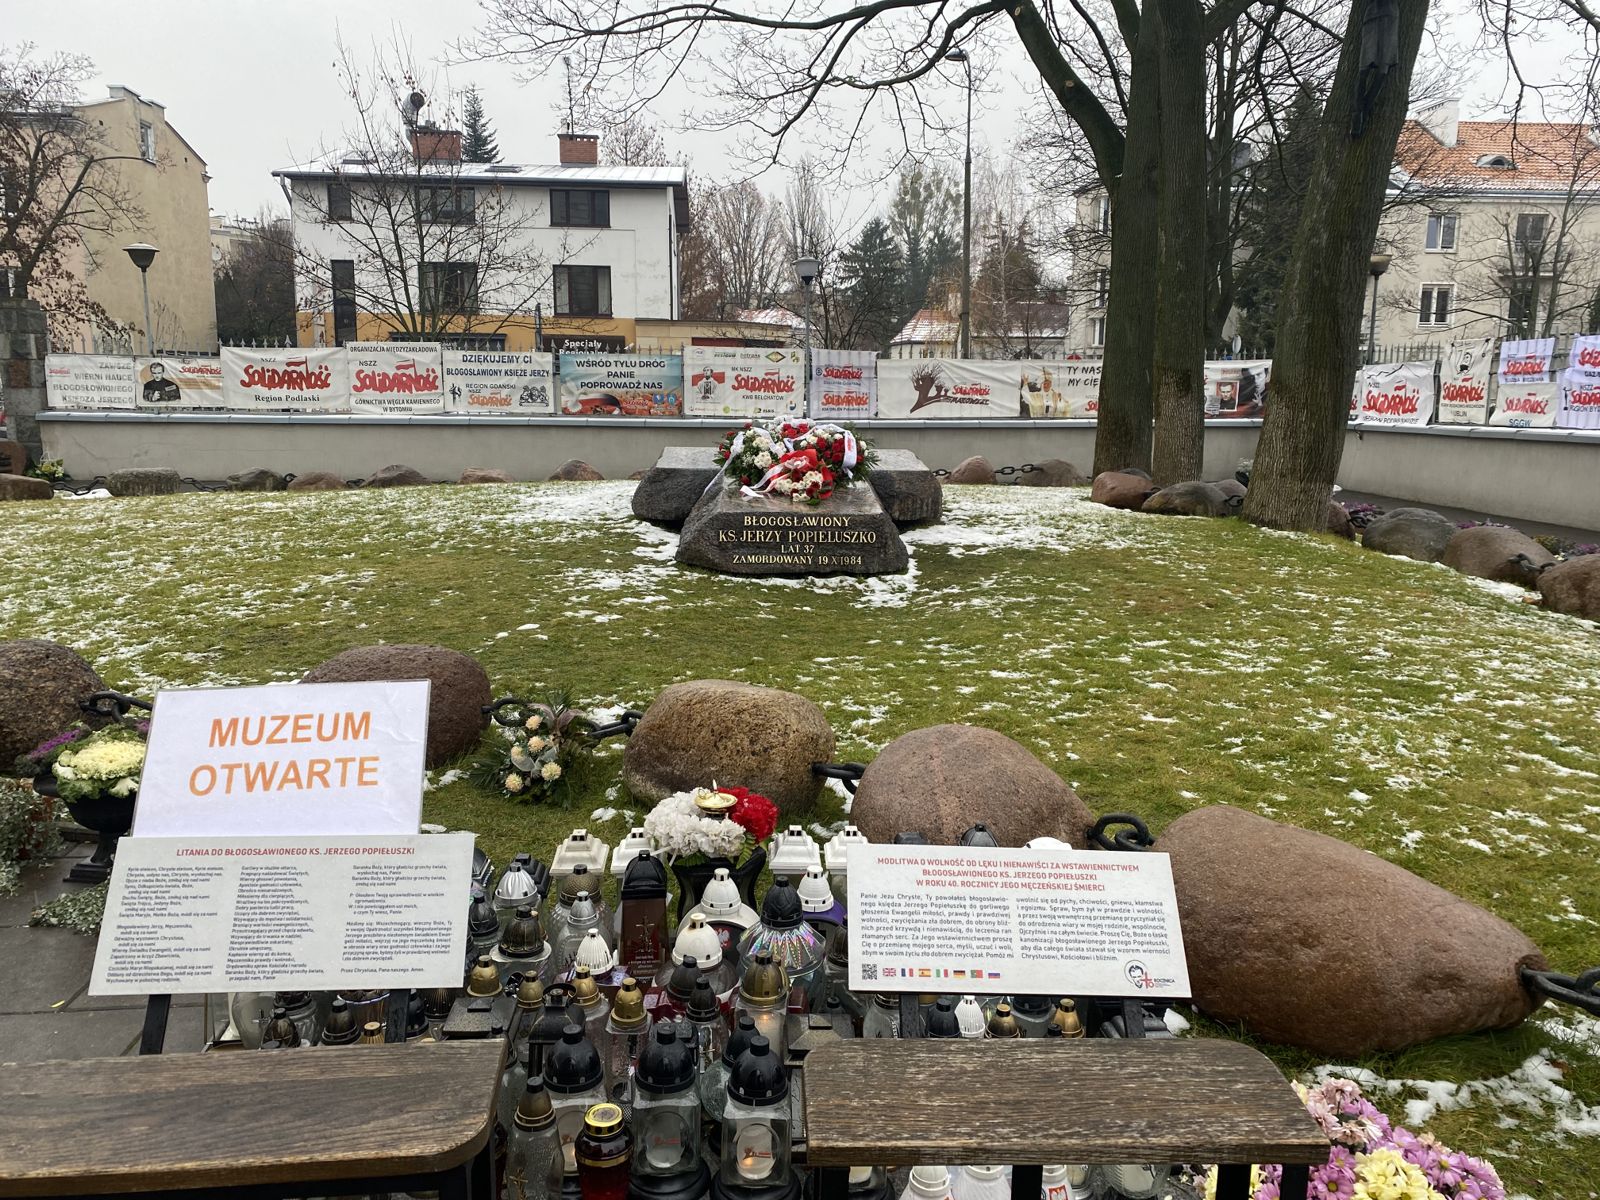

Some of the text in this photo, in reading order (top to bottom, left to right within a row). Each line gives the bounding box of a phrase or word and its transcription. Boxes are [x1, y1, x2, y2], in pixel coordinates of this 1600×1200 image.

[565, 340, 602, 348] Specjały
[462, 354, 520, 365] DZIĘKUJEMY
[576, 359, 611, 368] WŚRÓD
[639, 359, 665, 368] DRÓG
[446, 368, 502, 376] BŁOGOSŁAWIONY
[1068, 366, 1101, 374] TY NAS
[581, 381, 641, 389] POPROWADŹ
[255, 395, 282, 403] Region
[744, 516, 851, 526] BŁOGOSŁAWIONY
[719, 530, 737, 542] KS.
[740, 530, 782, 542] JERZY
[781, 545, 814, 553] LAT 37
[733, 555, 813, 564] ZAMORDOWANY
[818, 555, 828, 564] 19
[840, 556, 862, 564] 1984
[209, 712, 371, 748] MUZEUM
[189, 756, 380, 797] OTWARTE
[926, 858, 964, 866] WOLNOŚĆ
[1061, 863, 1139, 871] WSTAWIENNICTWEM
[922, 869, 998, 877] BŁOGOSŁAWIONEGO
[1047, 872, 1097, 880] POPIEŁUSZKI
[1020, 882, 1072, 890] MĘCZEŃSKIEJ
